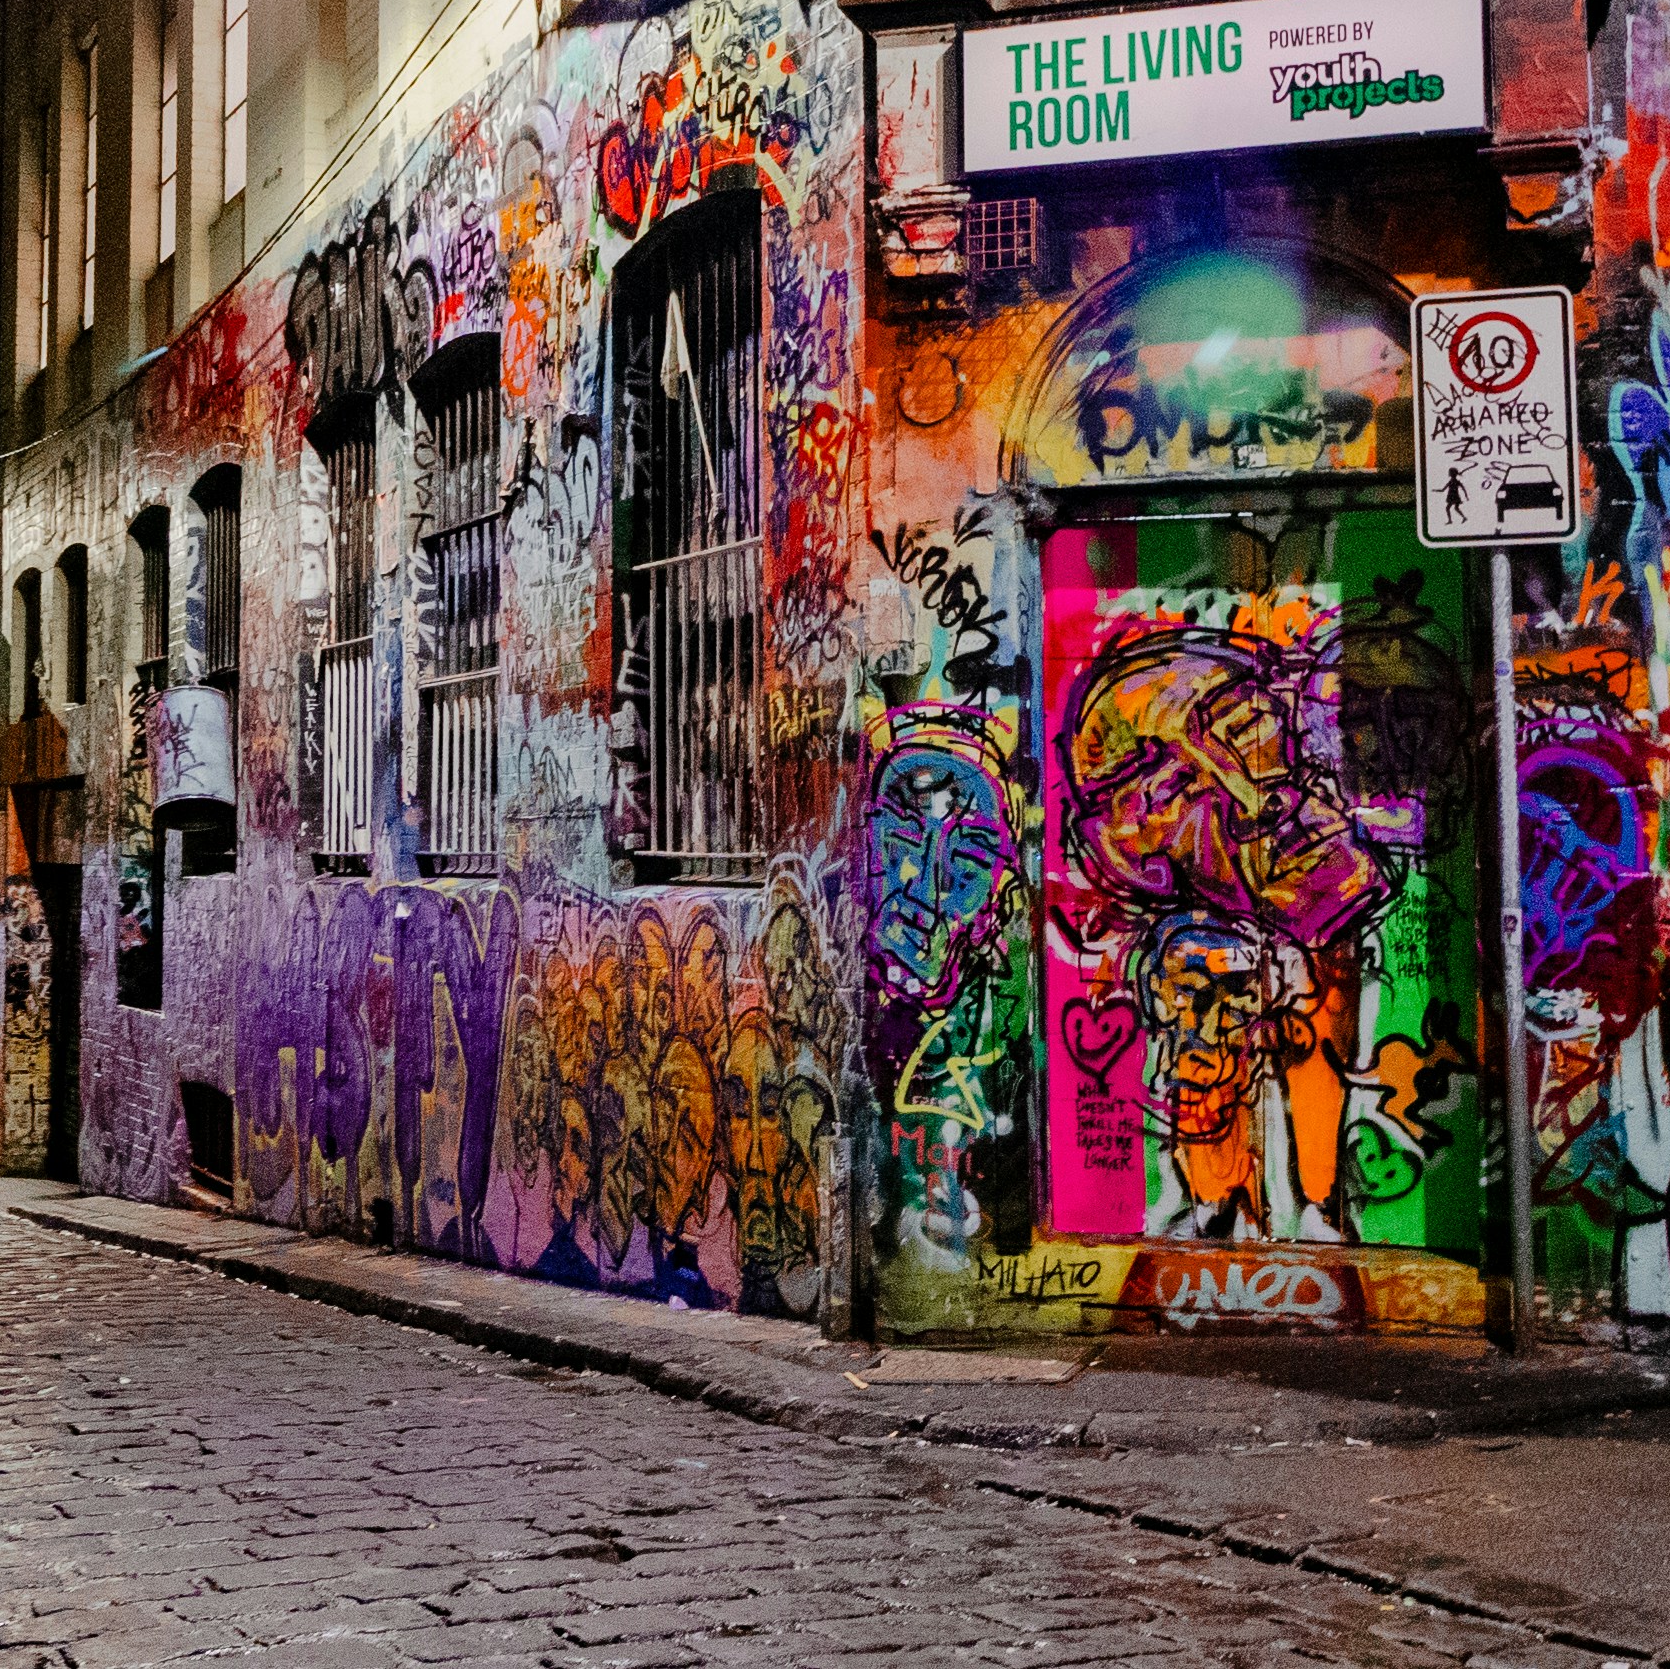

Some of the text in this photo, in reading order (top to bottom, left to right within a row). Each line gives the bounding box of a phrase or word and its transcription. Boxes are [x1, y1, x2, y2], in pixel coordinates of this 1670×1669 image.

[1006, 21, 1243, 94] THE LIVING
[1269, 21, 1374, 49] POWERED BY
[1269, 50, 1382, 103] youth
[1290, 69, 1445, 121] projects
[1009, 90, 1130, 151] ROOM
[1461, 433, 1533, 457] ZONE
